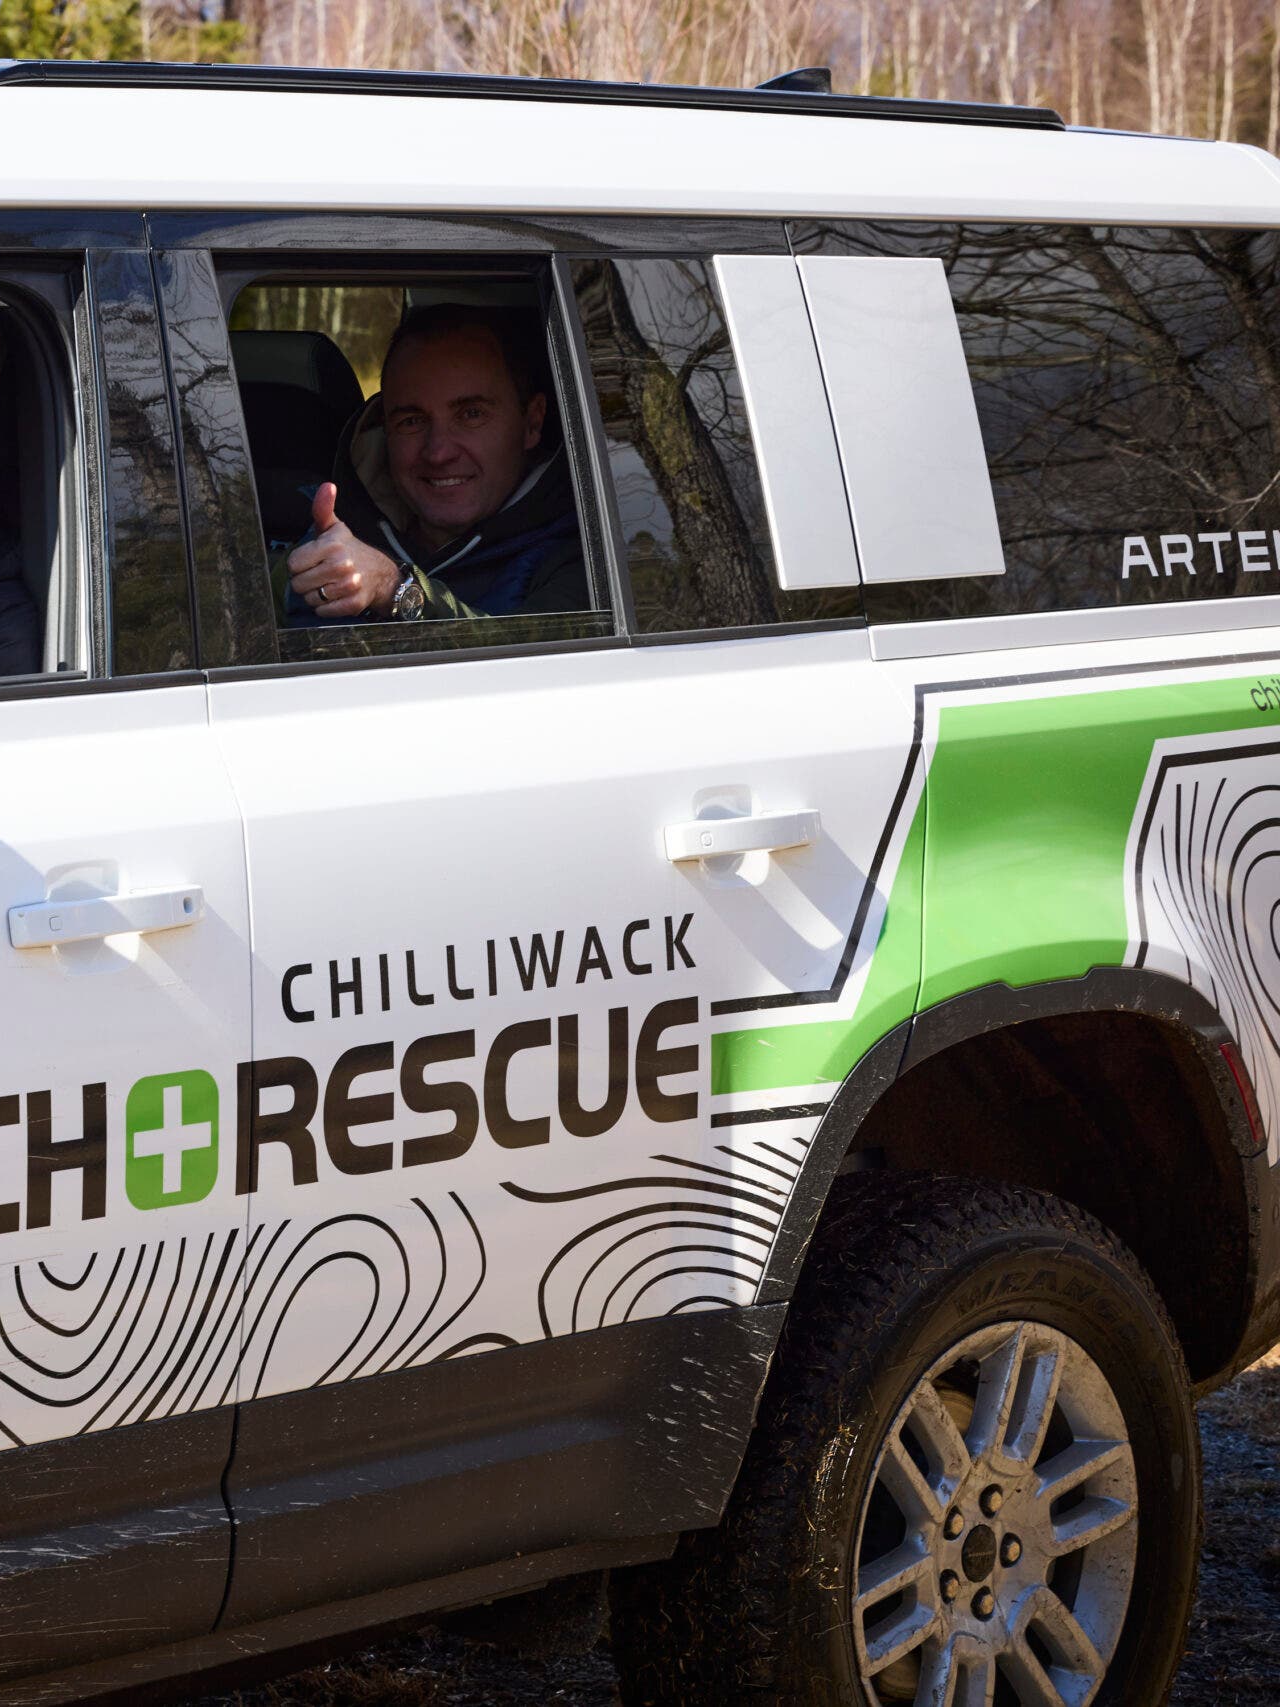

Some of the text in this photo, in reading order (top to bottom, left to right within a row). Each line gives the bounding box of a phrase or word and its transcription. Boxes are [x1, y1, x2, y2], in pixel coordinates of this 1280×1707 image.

[1122, 530, 1280, 579] ARTE
[281, 912, 697, 1023] CHILLIWACK
[235, 996, 699, 1195] RESCUE
